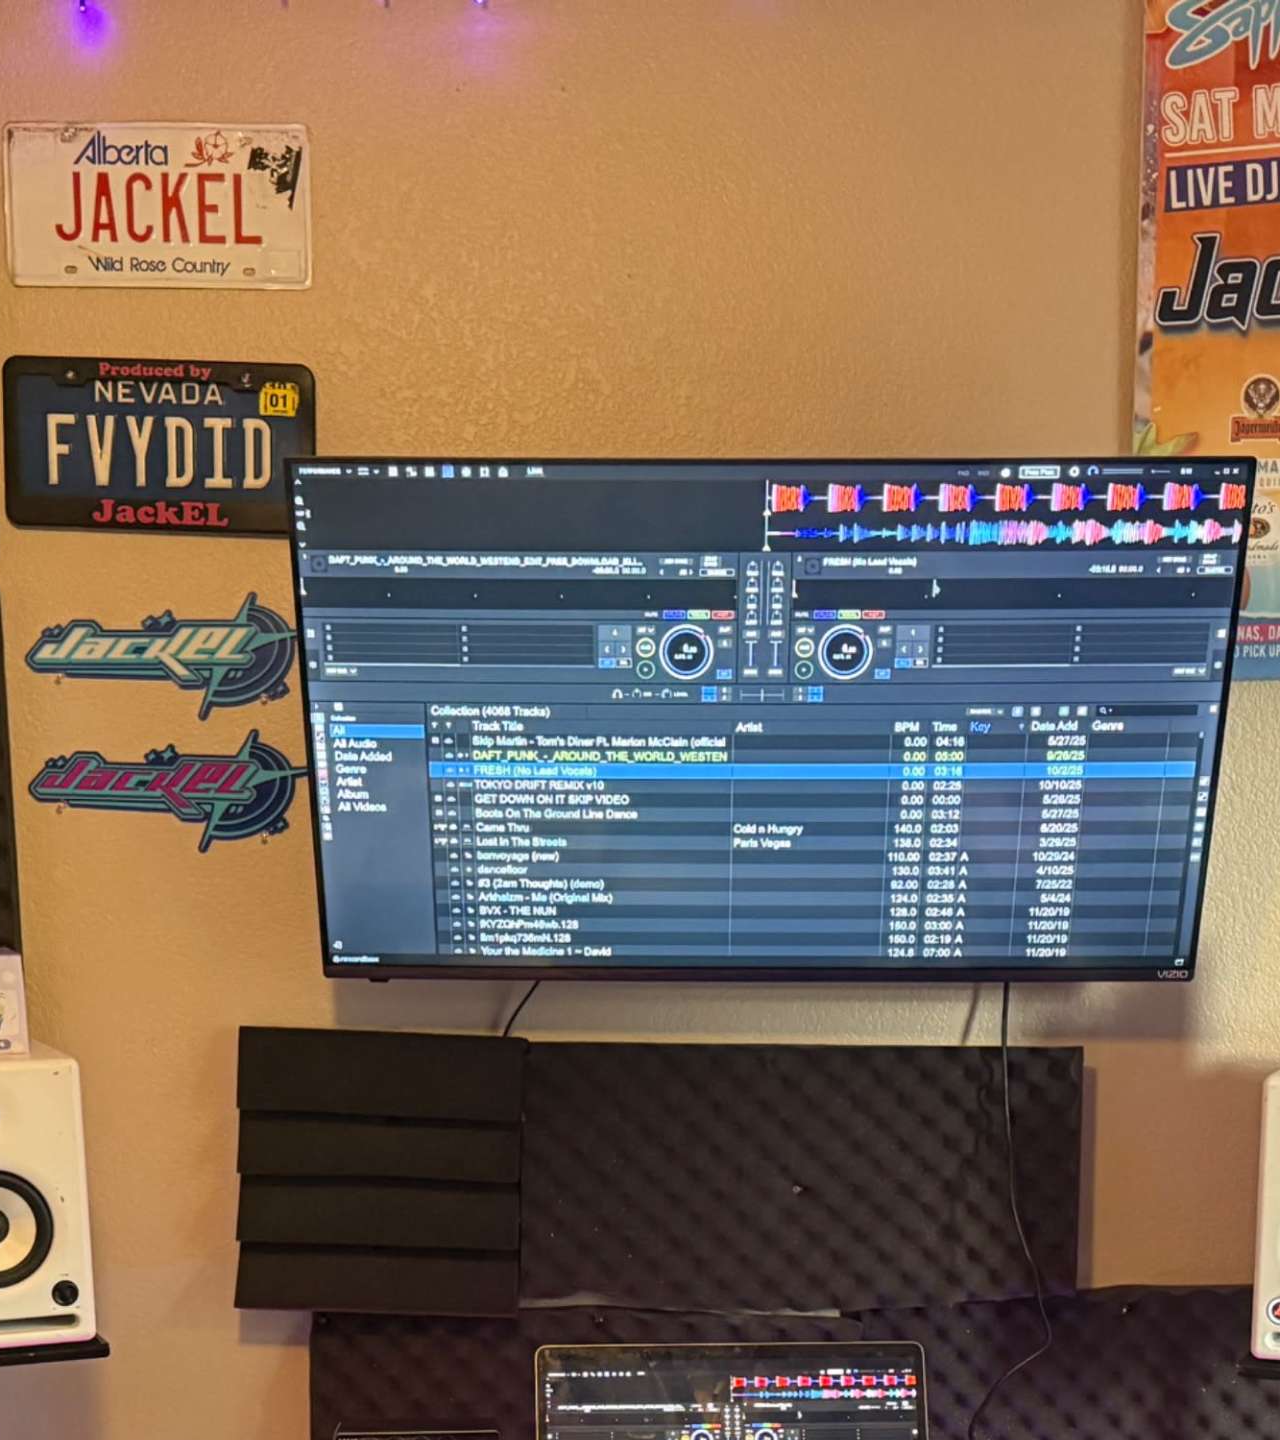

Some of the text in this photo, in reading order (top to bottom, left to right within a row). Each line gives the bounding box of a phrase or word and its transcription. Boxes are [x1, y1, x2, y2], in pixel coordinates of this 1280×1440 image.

[1162, 88, 1238, 145] SAT
[74, 131, 168, 167] Alberta
[1169, 167, 1235, 209] LIVE
[1246, 163, 1279, 203] DJ
[55, 171, 262, 245] JACKEL
[89, 256, 230, 277] Wild Rose Country
[99, 363, 211, 380] Produced by
[94, 381, 224, 405] NEVADA
[270, 394, 287, 408] 01
[46, 414, 272, 489] FVYDID
[92, 499, 229, 527] JackEL
[1243, 644, 1266, 658] PICK
[431, 705, 551, 718] Collection Tracks)
[472, 721, 524, 731] Track Title
[735, 722, 763, 733] Artist
[894, 722, 919, 732] BPM
[932, 722, 957, 732] Time
[970, 722, 991, 735] Key
[1031, 722, 1078, 732] Date Add
[1092, 722, 1124, 732] Genre
[333, 739, 377, 748] All Audio
[472, 736, 726, 749] Skip Martin Tom's Diner Marion McClain (official
[904, 737, 927, 747] 0.00
[335, 751, 392, 761] Date Added
[903, 752, 927, 761] 0.00
[336, 764, 367, 774] Genre
[473, 767, 597, 777] FRESH (No Lead Vocals)
[903, 767, 925, 776] 0.00
[336, 777, 362, 786] Artist
[474, 780, 584, 789] TOKYO DRIFT REMIX
[902, 781, 924, 790] 0.00
[337, 789, 369, 799] Album
[475, 795, 497, 804] GET
[499, 795, 534, 804] DOWN
[555, 795, 565, 804] IT
[568, 795, 593, 804] SKIP
[595, 795, 630, 805] VIDEO
[901, 796, 923, 805] 0.00
[338, 802, 387, 812] All Videos
[475, 809, 638, 820] Boots On The Ground Line Dance
[900, 810, 923, 820] 0.00
[931, 810, 960, 820] 03:12
[476, 823, 530, 832] Came Thru
[733, 824, 803, 836] Cold Hungry
[894, 824, 921, 834] 140.0
[476, 838, 498, 847] Lost
[511, 838, 530, 847] The
[532, 837, 567, 847] Streets
[733, 839, 792, 850] Paris Vegas
[887, 852, 920, 862] 110.00
[929, 852, 957, 862] 02:37
[892, 866, 919, 876] 130.0
[927, 866, 955, 876] 03:41
[493, 879, 605, 890] (2am Thoughts) (demo)
[549, 893, 589, 904] (Original
[592, 893, 613, 904] Mix)
[509, 906, 531, 915] THE
[480, 947, 612, 956] Your the Medicine David
[1157, 969, 1189, 979] VIZIO
